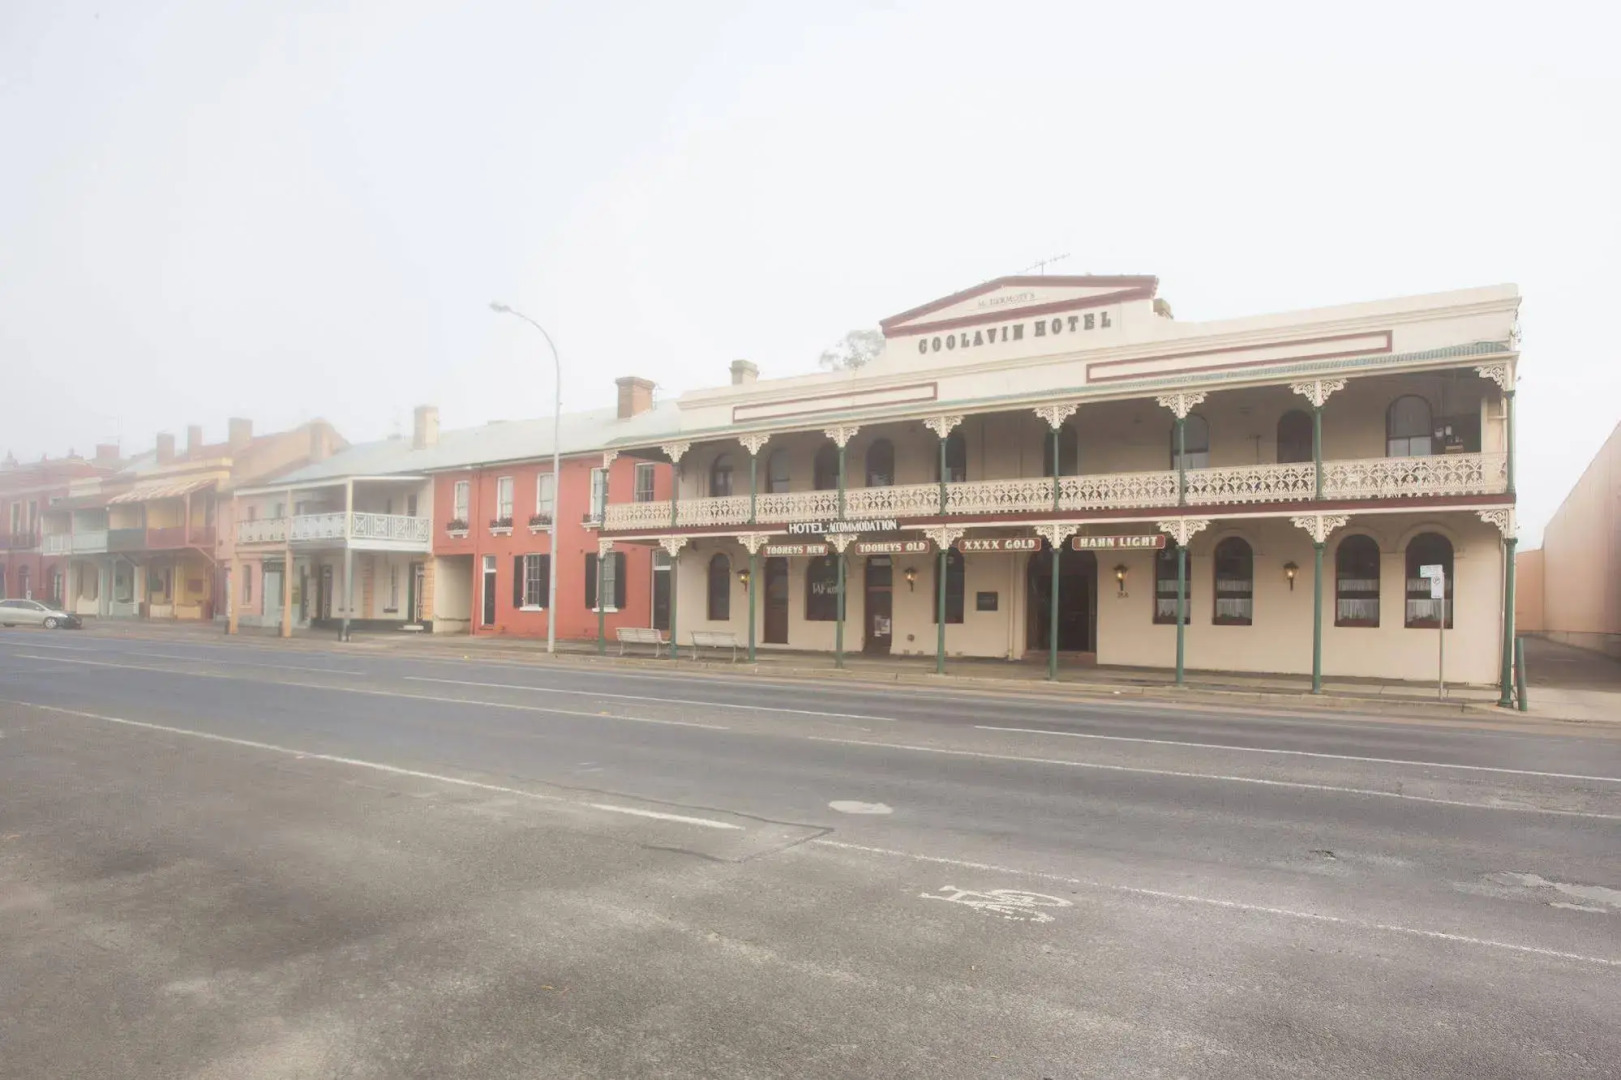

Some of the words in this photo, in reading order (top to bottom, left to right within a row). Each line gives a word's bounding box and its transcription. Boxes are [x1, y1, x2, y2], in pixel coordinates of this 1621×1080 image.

[1034, 311, 1111, 337] HOTEL
[788, 522, 827, 534] HOTEL
[829, 519, 897, 533] ACCOMMODATION
[859, 543, 902, 552] TOOHEYS
[906, 542, 926, 551] OLD
[964, 540, 1000, 550] XXXX
[1004, 539, 1036, 549] GOLD
[1080, 537, 1115, 548] HAHN
[1119, 536, 1157, 547] LIGHT
[766, 545, 803, 554] TOOHEYS
[807, 544, 826, 554] NEW
